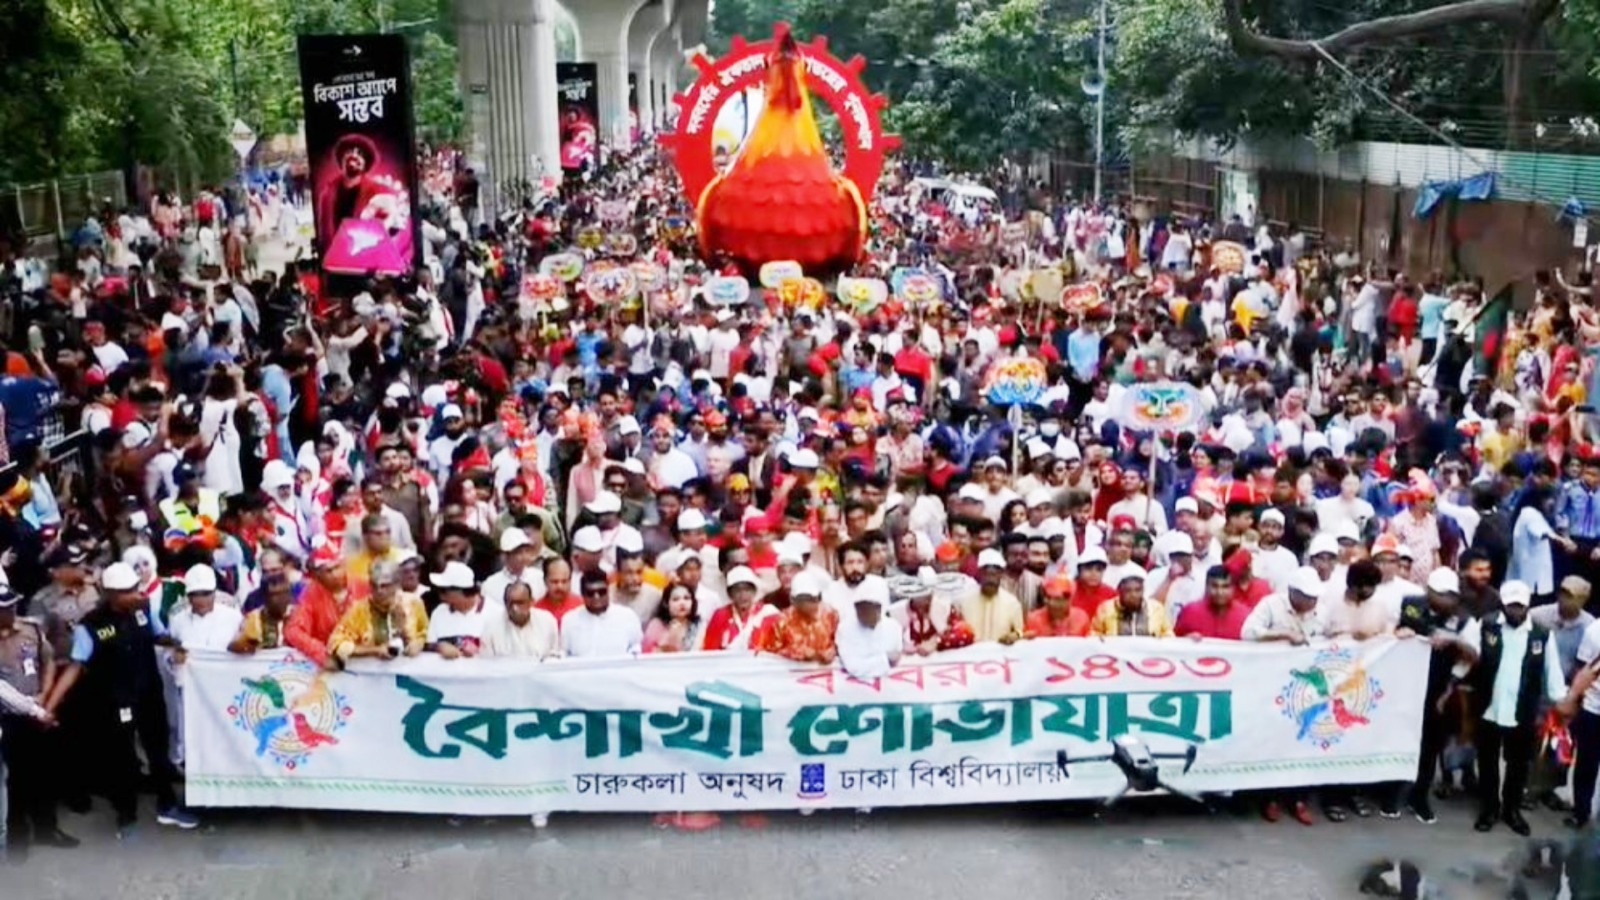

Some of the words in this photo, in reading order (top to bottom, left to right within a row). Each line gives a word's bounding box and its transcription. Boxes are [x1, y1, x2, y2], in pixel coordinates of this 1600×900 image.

[313, 83, 355, 103] বিকাশ
[357, 77, 397, 97] অ্যাপে
[336, 95, 384, 123] সম্ভব
[1045, 653, 1233, 683] ১৪৩৩
[396, 674, 769, 759] বৈশাখী
[787, 690, 1232, 757] শোভাযাত্রা
[573, 772, 686, 796] চারুকলা
[699, 771, 786, 800] অনুষদ
[839, 764, 901, 793] ঢাকা
